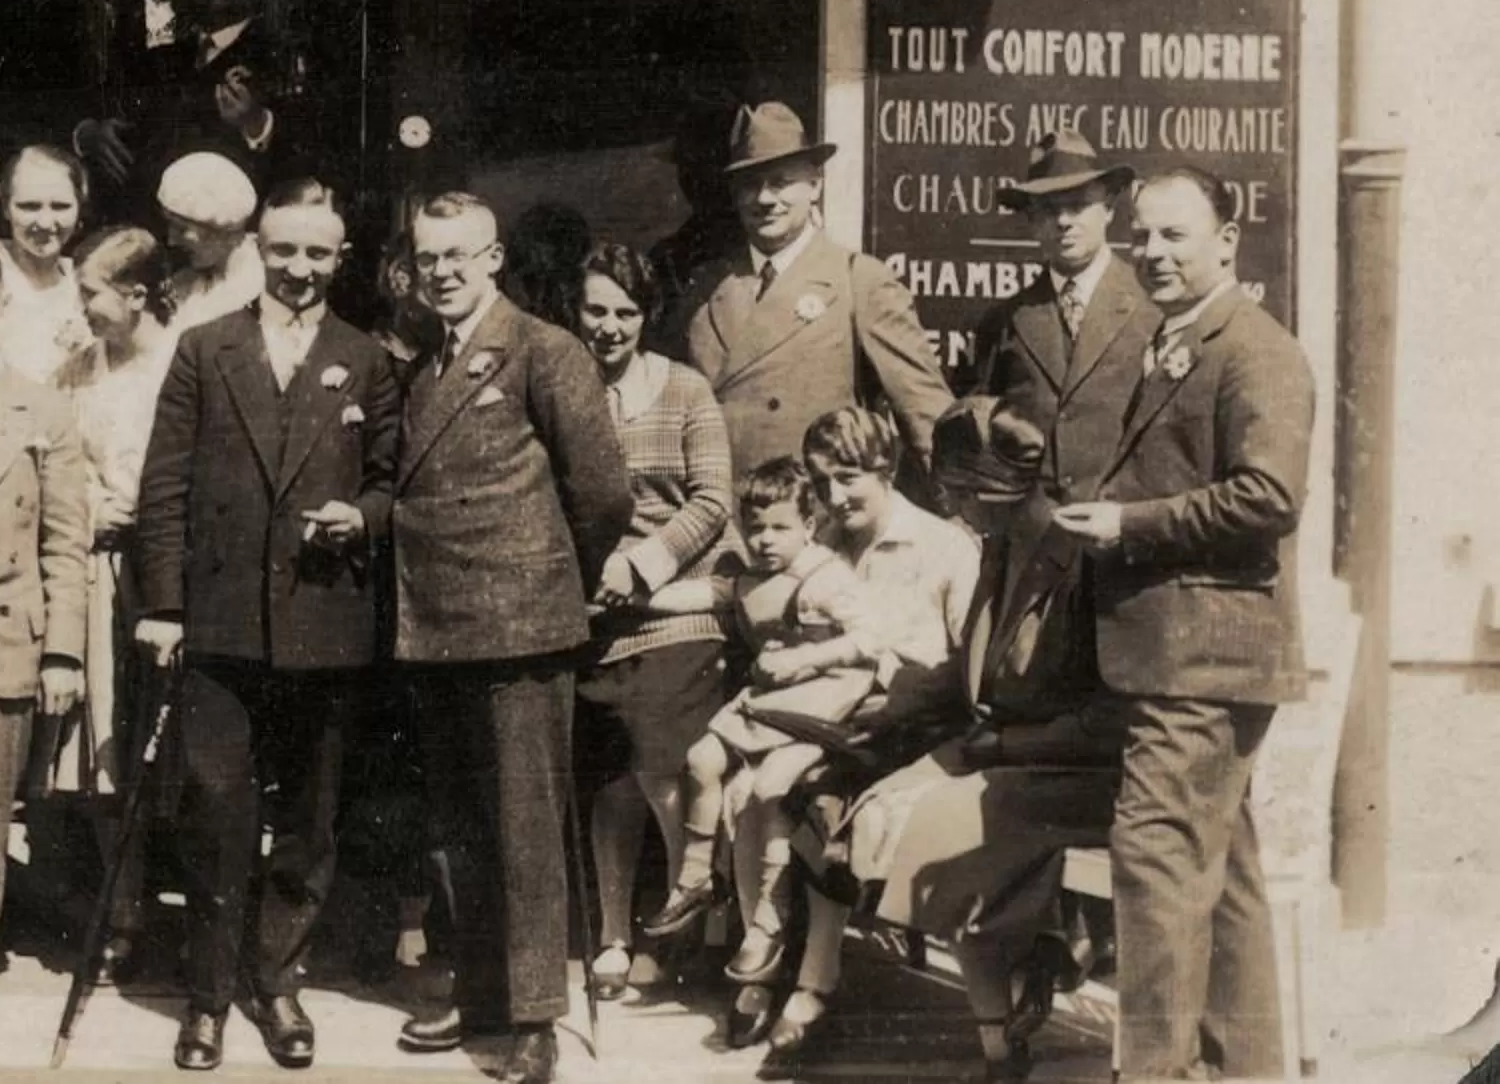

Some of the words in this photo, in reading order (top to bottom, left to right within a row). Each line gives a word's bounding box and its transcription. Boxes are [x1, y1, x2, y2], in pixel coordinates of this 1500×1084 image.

[888, 27, 969, 74] TOUT
[983, 29, 1125, 77] CONFORT
[1140, 32, 1282, 82] MODERNE
[879, 100, 1015, 147] CHAMBRES
[1026, 104, 1089, 146] AVEC
[1100, 106, 1149, 150] EAU
[1159, 107, 1286, 154] COURANTE
[893, 174, 1019, 215] CHAU
